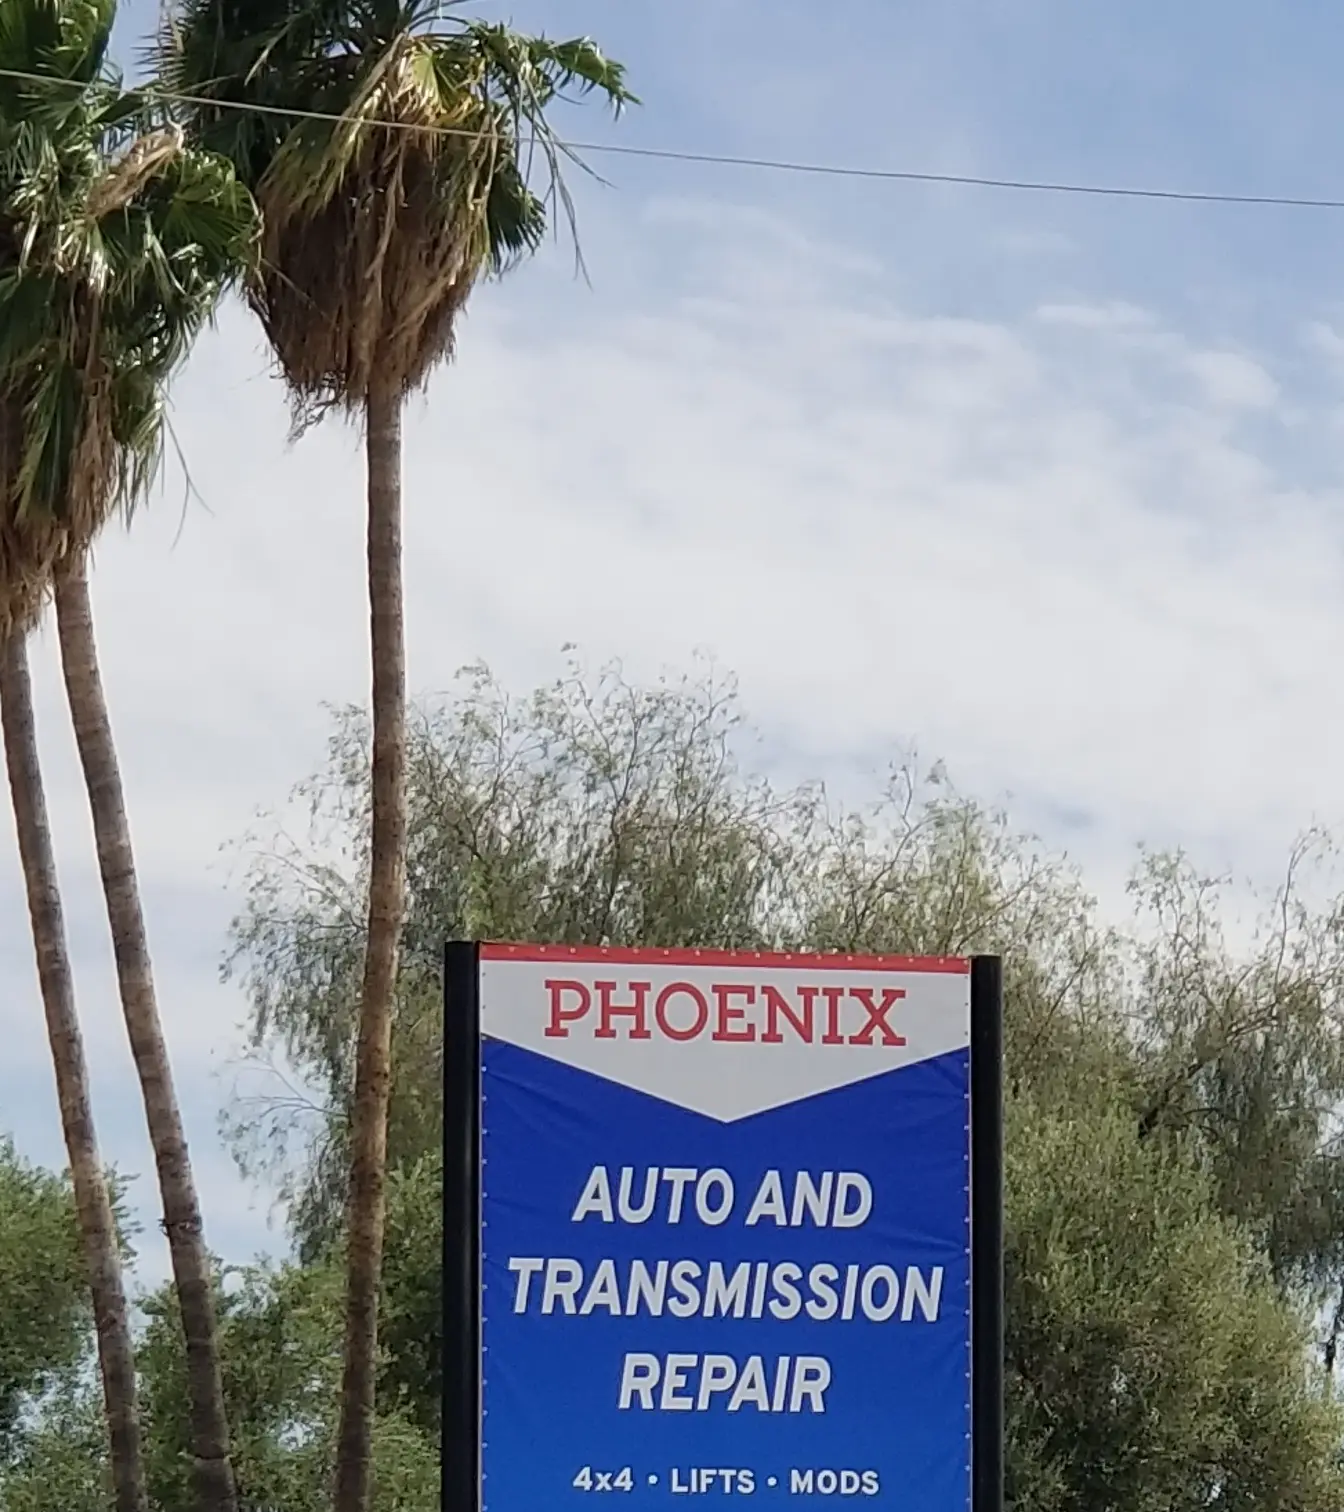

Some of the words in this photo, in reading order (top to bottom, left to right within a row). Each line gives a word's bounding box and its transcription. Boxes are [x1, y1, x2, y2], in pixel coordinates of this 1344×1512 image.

[544, 980, 907, 1047] PHOENIX
[571, 1165, 735, 1226] AUTO
[745, 1169, 873, 1229] AND
[508, 1257, 944, 1323] TRANSMISSION
[617, 1352, 831, 1414] REPAIR
[572, 1466, 634, 1493] 4x4
[670, 1468, 755, 1494] LIFTS
[789, 1468, 880, 1496] MODS
